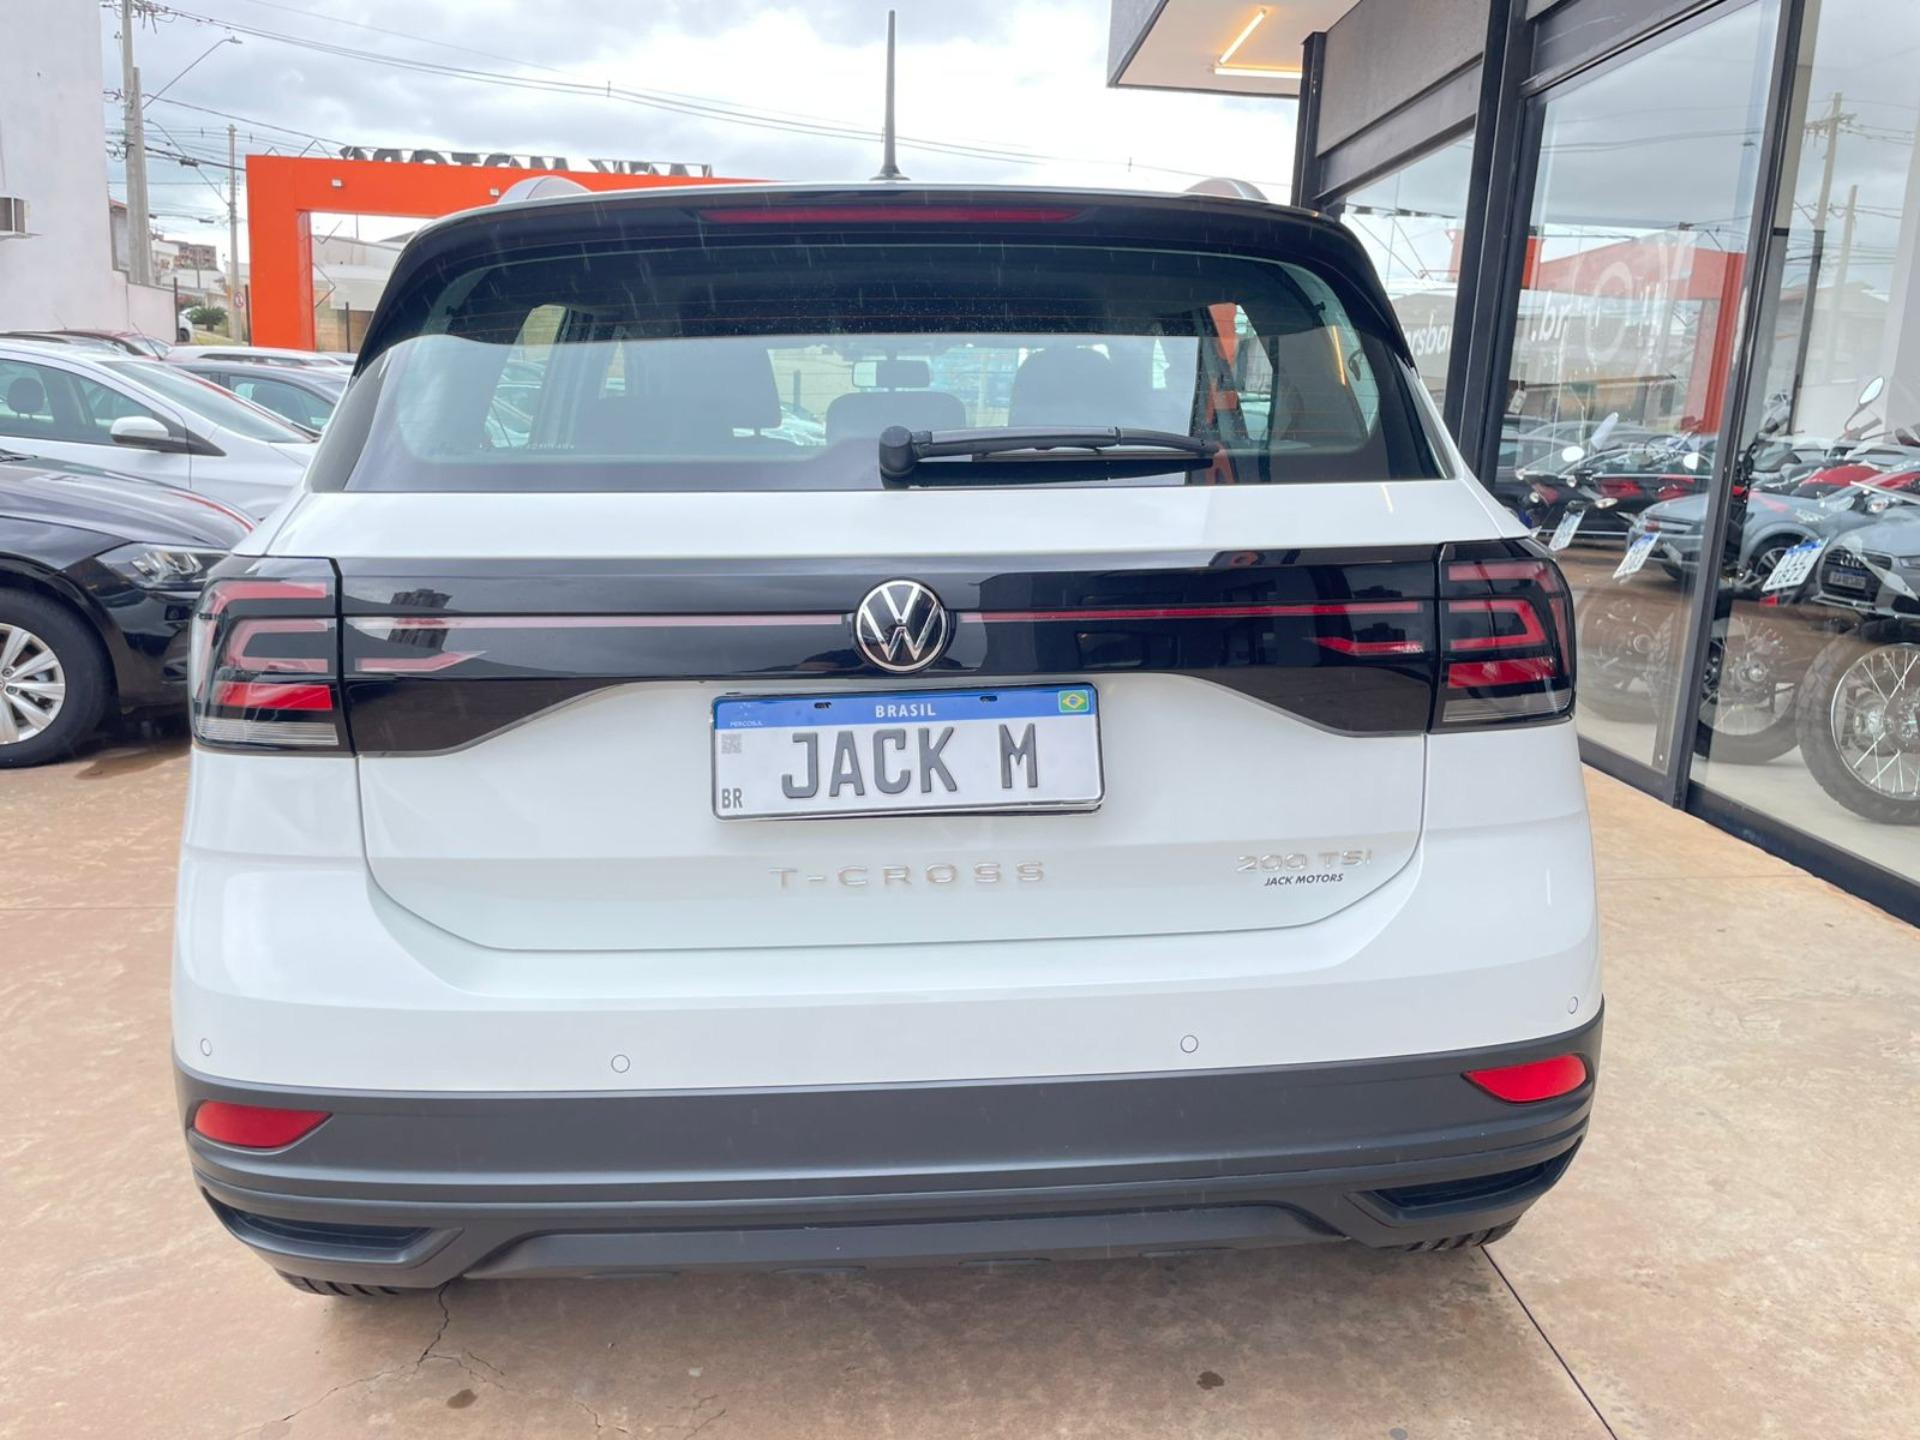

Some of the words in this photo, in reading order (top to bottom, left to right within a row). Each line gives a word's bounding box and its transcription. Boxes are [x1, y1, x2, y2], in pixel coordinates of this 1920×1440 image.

[875, 703, 936, 718] BRASIL
[781, 727, 957, 799] JACK
[999, 723, 1038, 789] M
[721, 787, 743, 809] BR
[1237, 853, 1308, 872] 200
[1318, 849, 1372, 868] TSI
[768, 861, 1044, 888] T-CROSS
[1264, 875, 1293, 886] JACK
[1295, 872, 1344, 885] MOTORS
